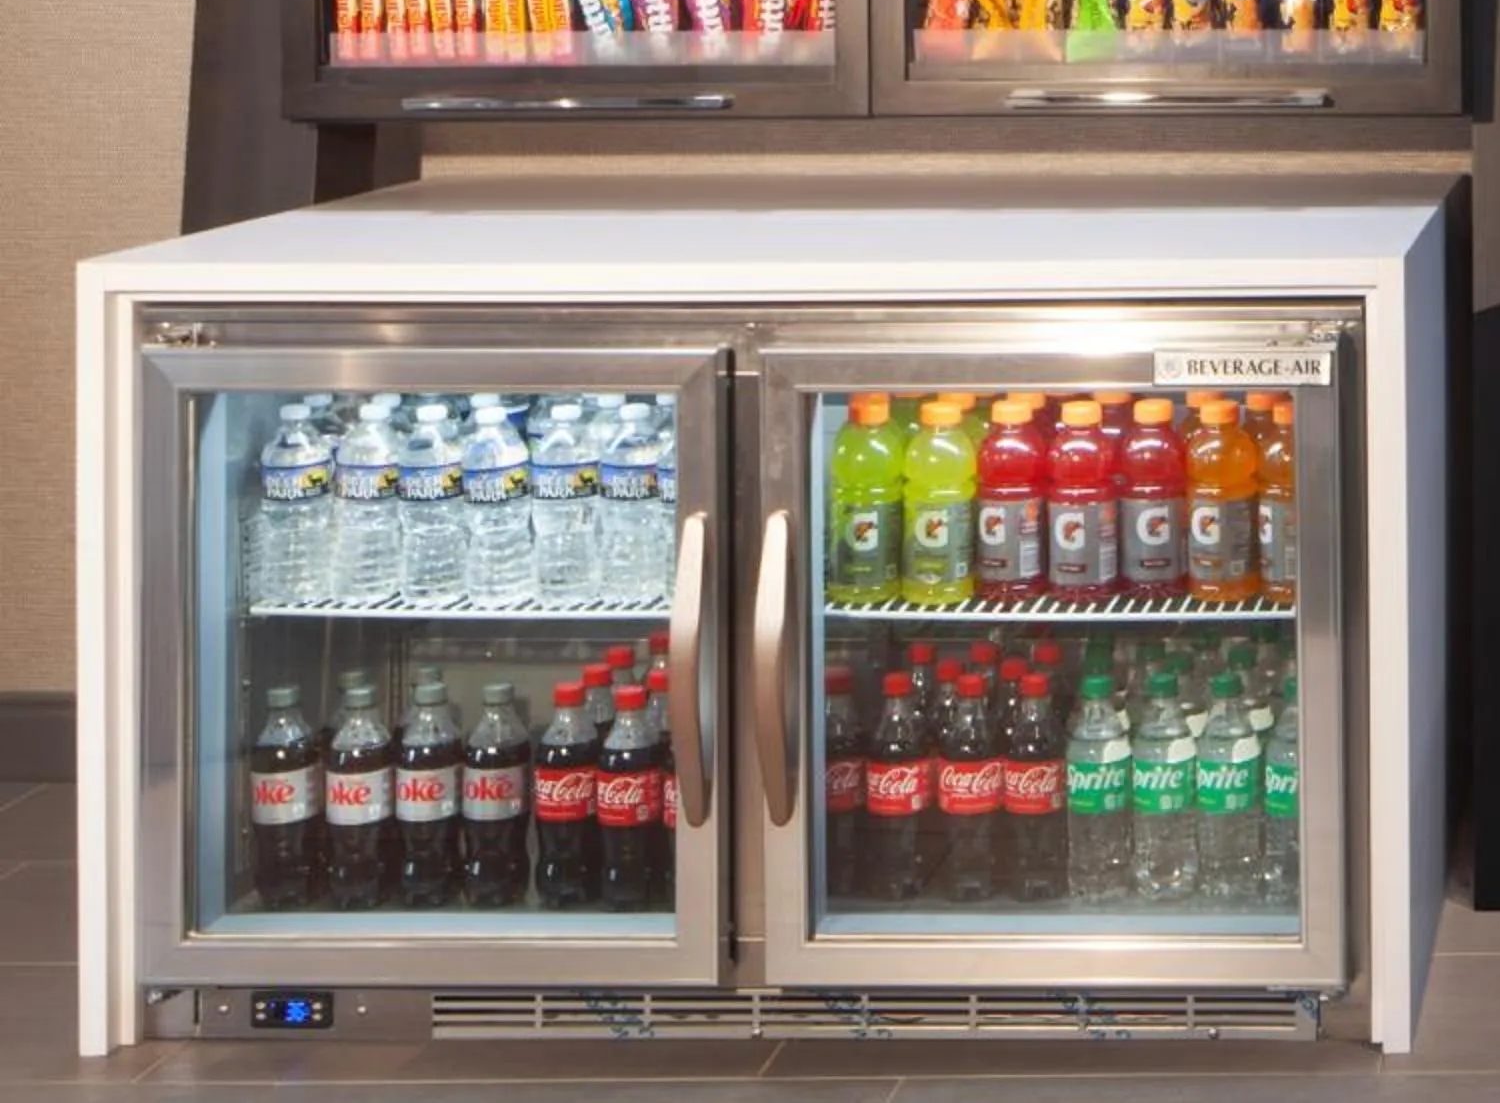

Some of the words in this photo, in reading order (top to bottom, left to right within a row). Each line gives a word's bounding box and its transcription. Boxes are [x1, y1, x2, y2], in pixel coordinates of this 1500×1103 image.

[1187, 358, 1322, 376] BEVERAGE-AIR
[915, 509, 949, 548] G
[979, 506, 1006, 546] G
[1054, 511, 1085, 551] G
[1136, 506, 1169, 545] G
[1191, 505, 1220, 545] G
[397, 775, 445, 803] oke
[465, 776, 513, 802] oke
[1132, 764, 1185, 790] prite
[1196, 764, 1249, 790] prite
